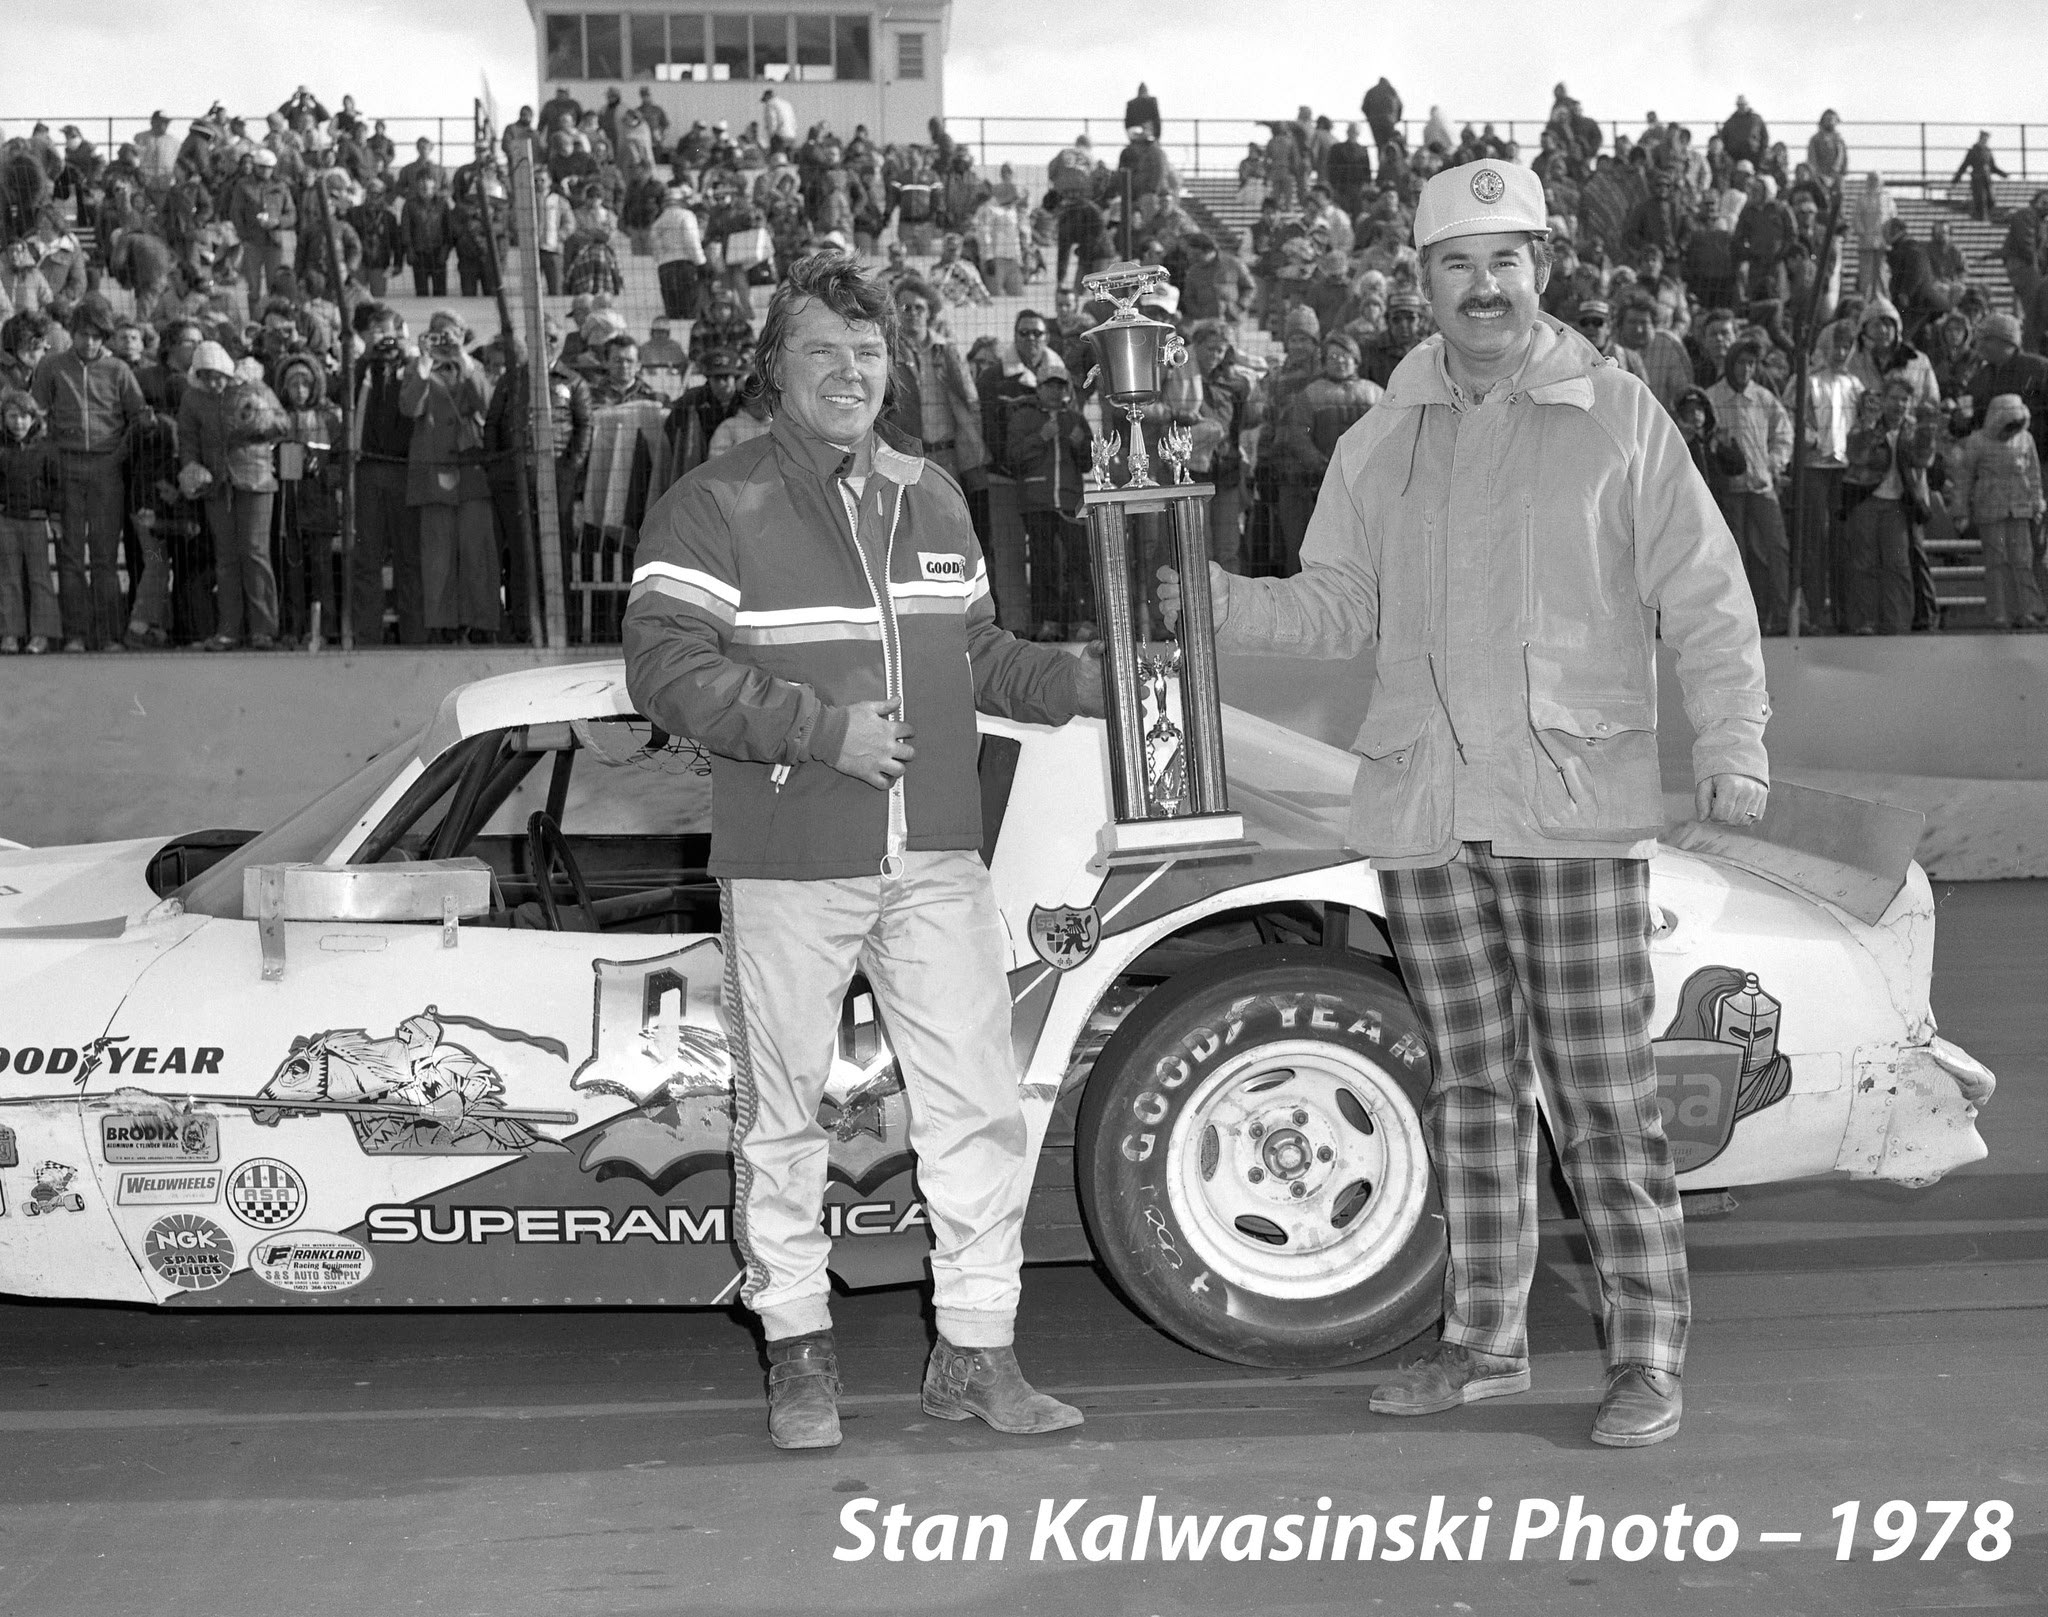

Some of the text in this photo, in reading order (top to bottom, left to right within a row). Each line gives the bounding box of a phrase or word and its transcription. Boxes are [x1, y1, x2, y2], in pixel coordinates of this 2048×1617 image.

[106, 1122, 179, 1141] BRODIX
[244, 1188, 290, 1201] ASA
[155, 1229, 218, 1250] NGK
[163, 1254, 219, 1265] SPARK
[267, 1246, 362, 1265] FRANKLAND
[166, 1265, 223, 1277] PLUGS
[293, 1262, 362, 1270] Racing Equipment
[294, 1270, 319, 1280] AUTO
[324, 1270, 361, 1280] SUPPLY
